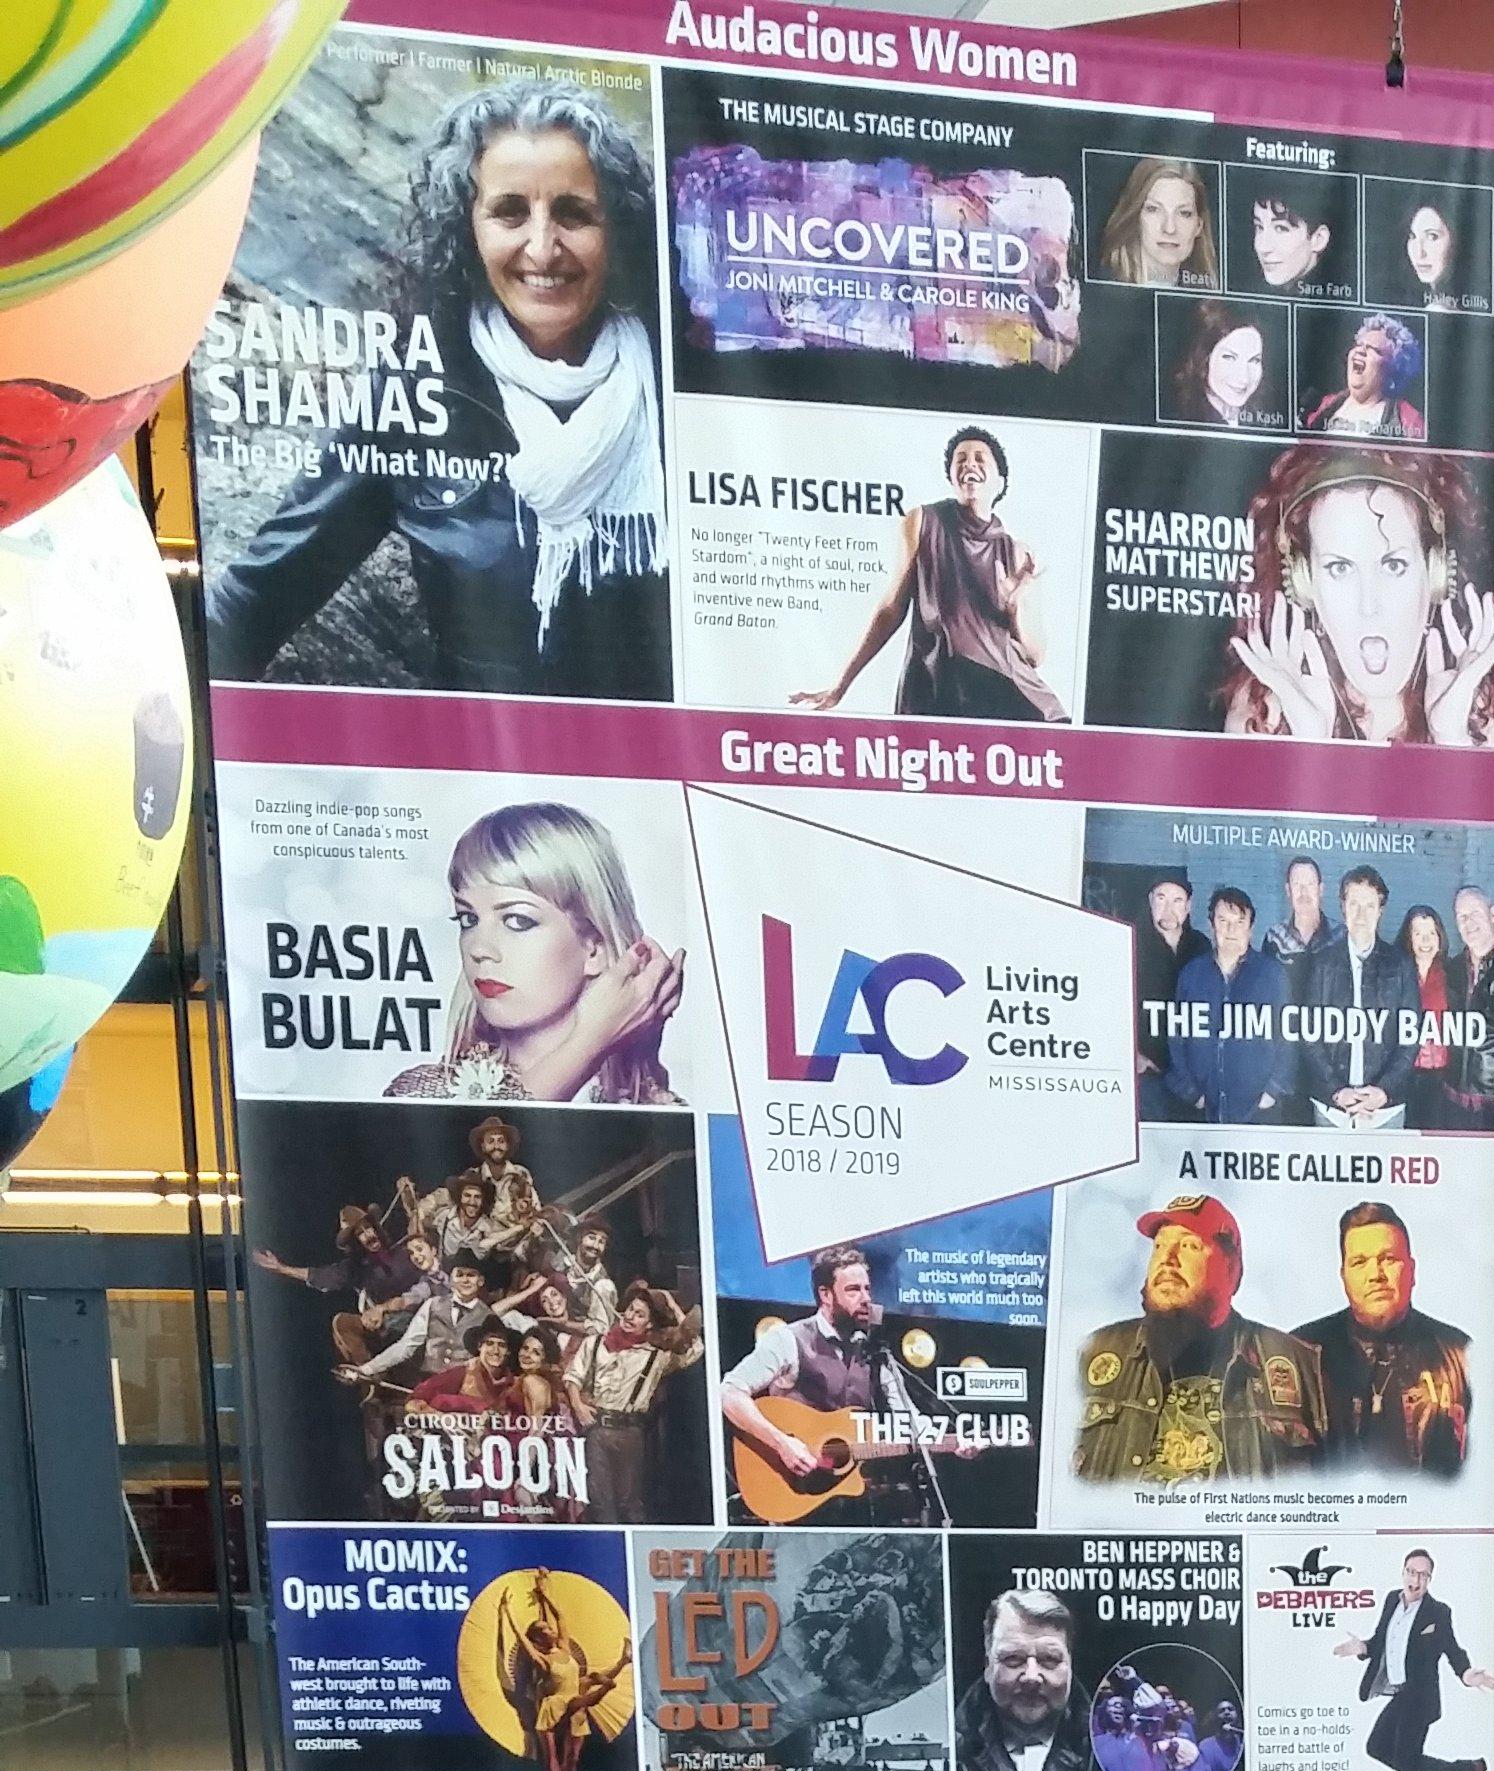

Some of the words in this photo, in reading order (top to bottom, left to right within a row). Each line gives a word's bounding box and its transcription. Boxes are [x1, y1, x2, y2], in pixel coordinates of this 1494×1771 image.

[665, 0, 898, 66] Audacious
[910, 27, 1077, 87] Women
[326, 45, 407, 66] Performer
[418, 51, 472, 74] Farmer
[485, 59, 540, 82] Natural
[591, 69, 643, 91] Blonde
[719, 98, 759, 123] THE
[763, 104, 850, 132] MUSICAL
[855, 113, 915, 139] STAGE
[920, 120, 1013, 148] COMPANY
[1246, 137, 1336, 167] Featuring:
[726, 209, 1030, 274] UNCOVERED
[725, 270, 774, 292] JONI
[779, 275, 873, 301] MITCHELL
[880, 284, 893, 302] &
[898, 284, 977, 309] CAROLE
[981, 293, 1030, 312] KING
[1298, 281, 1323, 296] Sara
[1327, 283, 1352, 297] Farb
[1423, 292, 1458, 309] Hailey
[1462, 295, 1489, 310] Gillis
[205, 300, 445, 375] SANDRA
[207, 365, 450, 436] SHAMAS
[1255, 410, 1284, 425] Kash
[209, 435, 266, 467] The
[275, 438, 322, 478] Big
[689, 471, 760, 508] LISA
[772, 476, 906, 516] FISCHER
[1105, 509, 1254, 552] SHARRON
[1105, 546, 1255, 583] MATTHEWS
[693, 571, 716, 584] and
[721, 572, 757, 587] world
[761, 574, 814, 593] rhythms
[818, 578, 846, 592] with
[850, 579, 870, 594] her
[1106, 584, 1260, 619] SUPERSTAR!
[720, 731, 844, 778] Great
[856, 737, 975, 791] Night
[985, 744, 1063, 788] Out
[255, 799, 312, 817] Dazzling
[316, 802, 379, 820] indie-pop
[384, 805, 422, 821] songs
[251, 821, 282, 835] from
[287, 825, 310, 837] one
[315, 824, 328, 836] of
[333, 824, 391, 838] Canada's
[396, 826, 428, 840] most
[1173, 824, 1261, 846] MULTIPLE
[1268, 828, 1415, 854] AWARD-WINNER
[273, 845, 355, 862] conspicuous
[267, 923, 433, 982] BASIA
[985, 965, 1079, 1000] Living
[762, 913, 969, 1086] LAC
[986, 998, 1051, 1026] Arts
[262, 992, 440, 1051] BULAT
[1143, 1000, 1210, 1038] THE
[1219, 1004, 1272, 1040] JIM
[1281, 1006, 1388, 1044] CUDDY
[1398, 1010, 1486, 1047] BAND
[987, 1032, 1090, 1060] Centre
[989, 1075, 1122, 1094] MISSISSAUGA
[767, 1102, 901, 1139] SEASON
[766, 1147, 821, 1172] 2018
[830, 1148, 837, 1173] /
[845, 1150, 900, 1175] 2019
[1179, 1151, 1197, 1179] A
[1204, 1151, 1279, 1180] TRIBE
[1288, 1153, 1383, 1183] CALLED
[1390, 1157, 1439, 1184] RED
[969, 1378, 1020, 1390] SOULPEPPER
[404, 1413, 483, 1431] CIRQUE
[849, 1412, 910, 1443] THE
[917, 1415, 947, 1445] 27
[955, 1414, 1031, 1446] CLUB
[382, 1434, 590, 1503] SALOON
[1135, 1492, 1154, 1505] The
[1158, 1492, 1186, 1508] pulse
[1189, 1492, 1201, 1505] of
[1204, 1492, 1228, 1506] First
[1231, 1492, 1270, 1506] Nations
[1274, 1492, 1304, 1506] music
[1307, 1492, 1354, 1506] becomes
[1357, 1495, 1364, 1505] a
[1367, 1492, 1407, 1506] modern
[1205, 1511, 1242, 1523] electric
[1246, 1511, 1277, 1523] dance
[1281, 1511, 1339, 1524] soundtrack
[344, 1540, 468, 1573] MOMIX:
[649, 1549, 707, 1579] GET
[714, 1548, 776, 1580] THE
[1083, 1541, 1124, 1562] BEN
[1130, 1541, 1224, 1563] HEPPNER
[1229, 1543, 1240, 1562] &
[1012, 1568, 1113, 1590] TORONTO
[1119, 1569, 1175, 1590] MASS
[1180, 1569, 1240, 1590] CHOIR
[1298, 1570, 1327, 1584] the
[282, 1578, 360, 1618] Opus
[367, 1579, 470, 1611] Cactus
[1099, 1595, 1114, 1620] O
[1121, 1595, 1192, 1625] Happy
[1198, 1596, 1241, 1625] Day
[1257, 1590, 1375, 1609] DEBATERS
[1293, 1613, 1335, 1627] LIVE
[654, 1590, 781, 1694] LED
[656, 1702, 776, 1730] OUT
